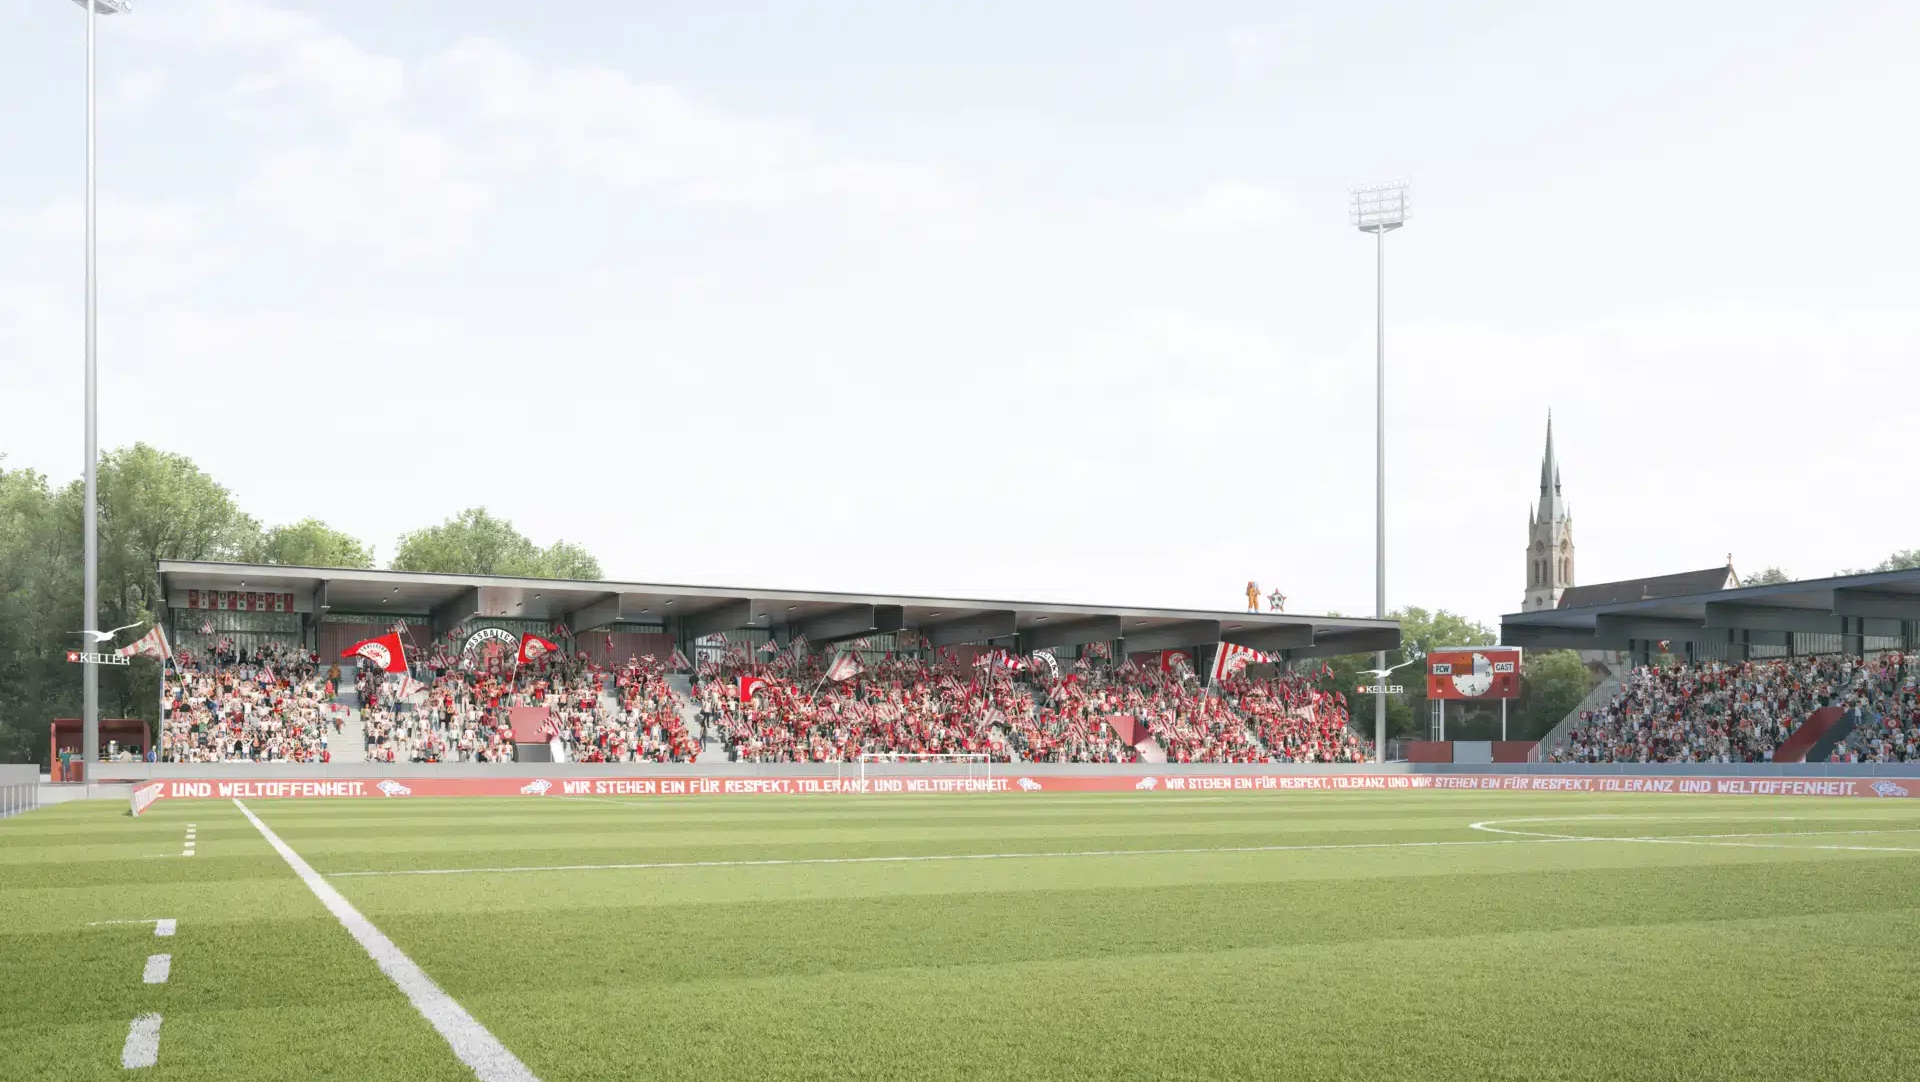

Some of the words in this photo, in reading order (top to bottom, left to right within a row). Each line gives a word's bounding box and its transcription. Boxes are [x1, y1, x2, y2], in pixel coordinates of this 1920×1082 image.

[80, 652, 131, 665] KELLER
[1435, 665, 1450, 673] FCW
[1495, 663, 1513, 671] GAST
[1366, 685, 1404, 694] KELLER
[171, 782, 212, 797] UND
[219, 781, 368, 797] WELTOFFENHEIT.
[563, 780, 591, 794] WIR
[596, 779, 655, 794] STEHEN
[661, 779, 685, 794] EIN
[690, 777, 720, 793] FÜR
[725, 779, 795, 794] RESPEKT,
[795, 779, 869, 793] TOLERANZ
[874, 779, 901, 792] UND
[1165, 777, 1185, 789] WIR
[1188, 777, 1231, 789] STEHEN
[1234, 777, 1251, 789] EIN
[1255, 776, 1277, 789] FÜR
[1332, 777, 1385, 788] TOLERANZ
[1388, 777, 1409, 788] UND
[1434, 777, 1478, 789] STEHEN
[1481, 777, 1501, 789] EIN
[1503, 776, 1529, 789] FÜR
[1599, 778, 1673, 792] TOLERANZ
[1679, 780, 1711, 792] UND
[1717, 780, 1858, 795] WELTOFFENHEIT.
